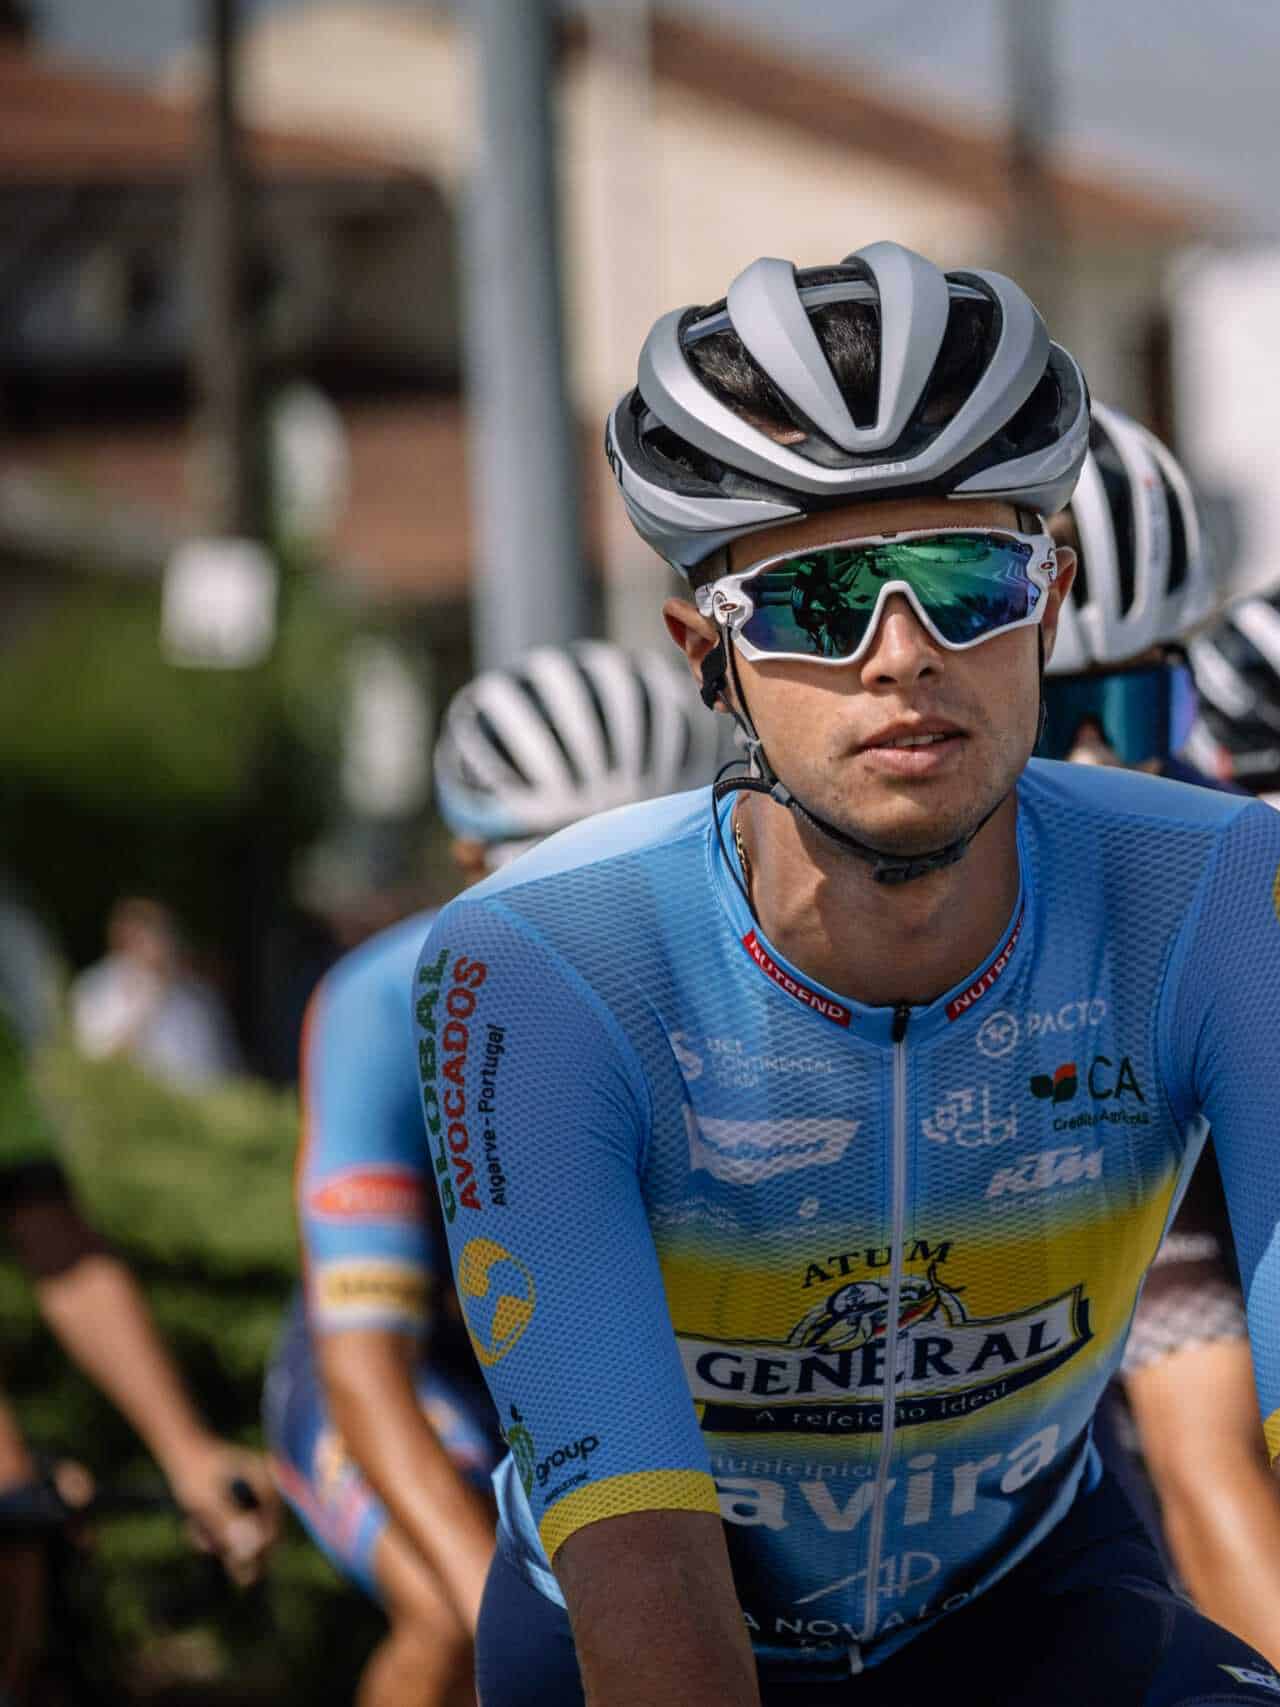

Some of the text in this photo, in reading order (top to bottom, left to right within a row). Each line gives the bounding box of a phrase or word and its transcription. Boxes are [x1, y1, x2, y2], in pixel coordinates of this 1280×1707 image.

[749, 938, 846, 1019] NUTREND
[1026, 1000, 1107, 1038] PACTO
[416, 948, 457, 1225] GLOBAL
[442, 955, 488, 1211] AVOCADOS
[1088, 1055, 1147, 1107] CA
[984, 1145, 1104, 1198] KTM
[802, 1240, 953, 1288] ATUM
[696, 1320, 1061, 1395] GENERAL
[536, 1436, 599, 1487] group
[716, 1423, 1061, 1532] avira
